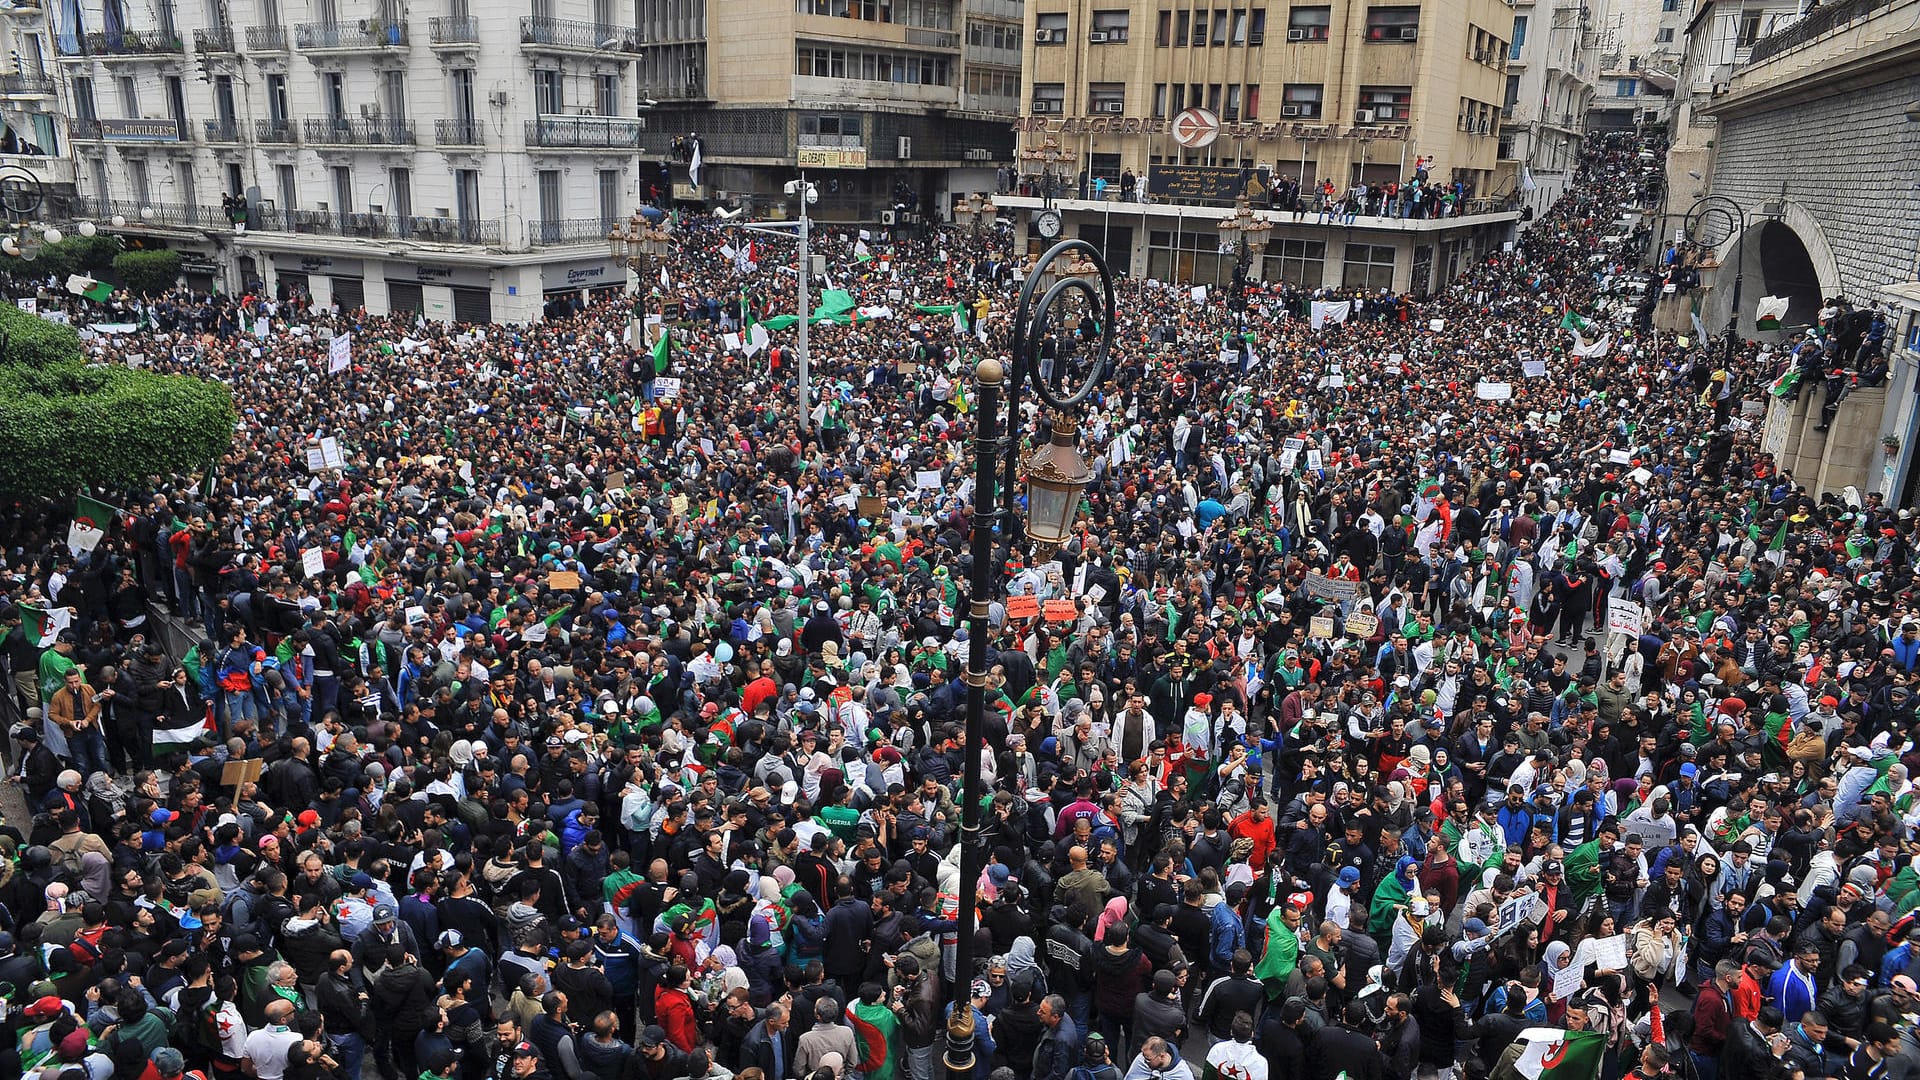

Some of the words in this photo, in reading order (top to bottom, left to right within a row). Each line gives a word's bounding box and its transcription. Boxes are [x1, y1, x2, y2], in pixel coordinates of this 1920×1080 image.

[1011, 117, 1048, 133] AIR
[1059, 115, 1166, 135] ALGÉRIE
[125, 125, 169, 136] PRIVILEGES
[1075, 810, 1092, 818] CITY
[825, 818, 851, 826] ALGERIA
